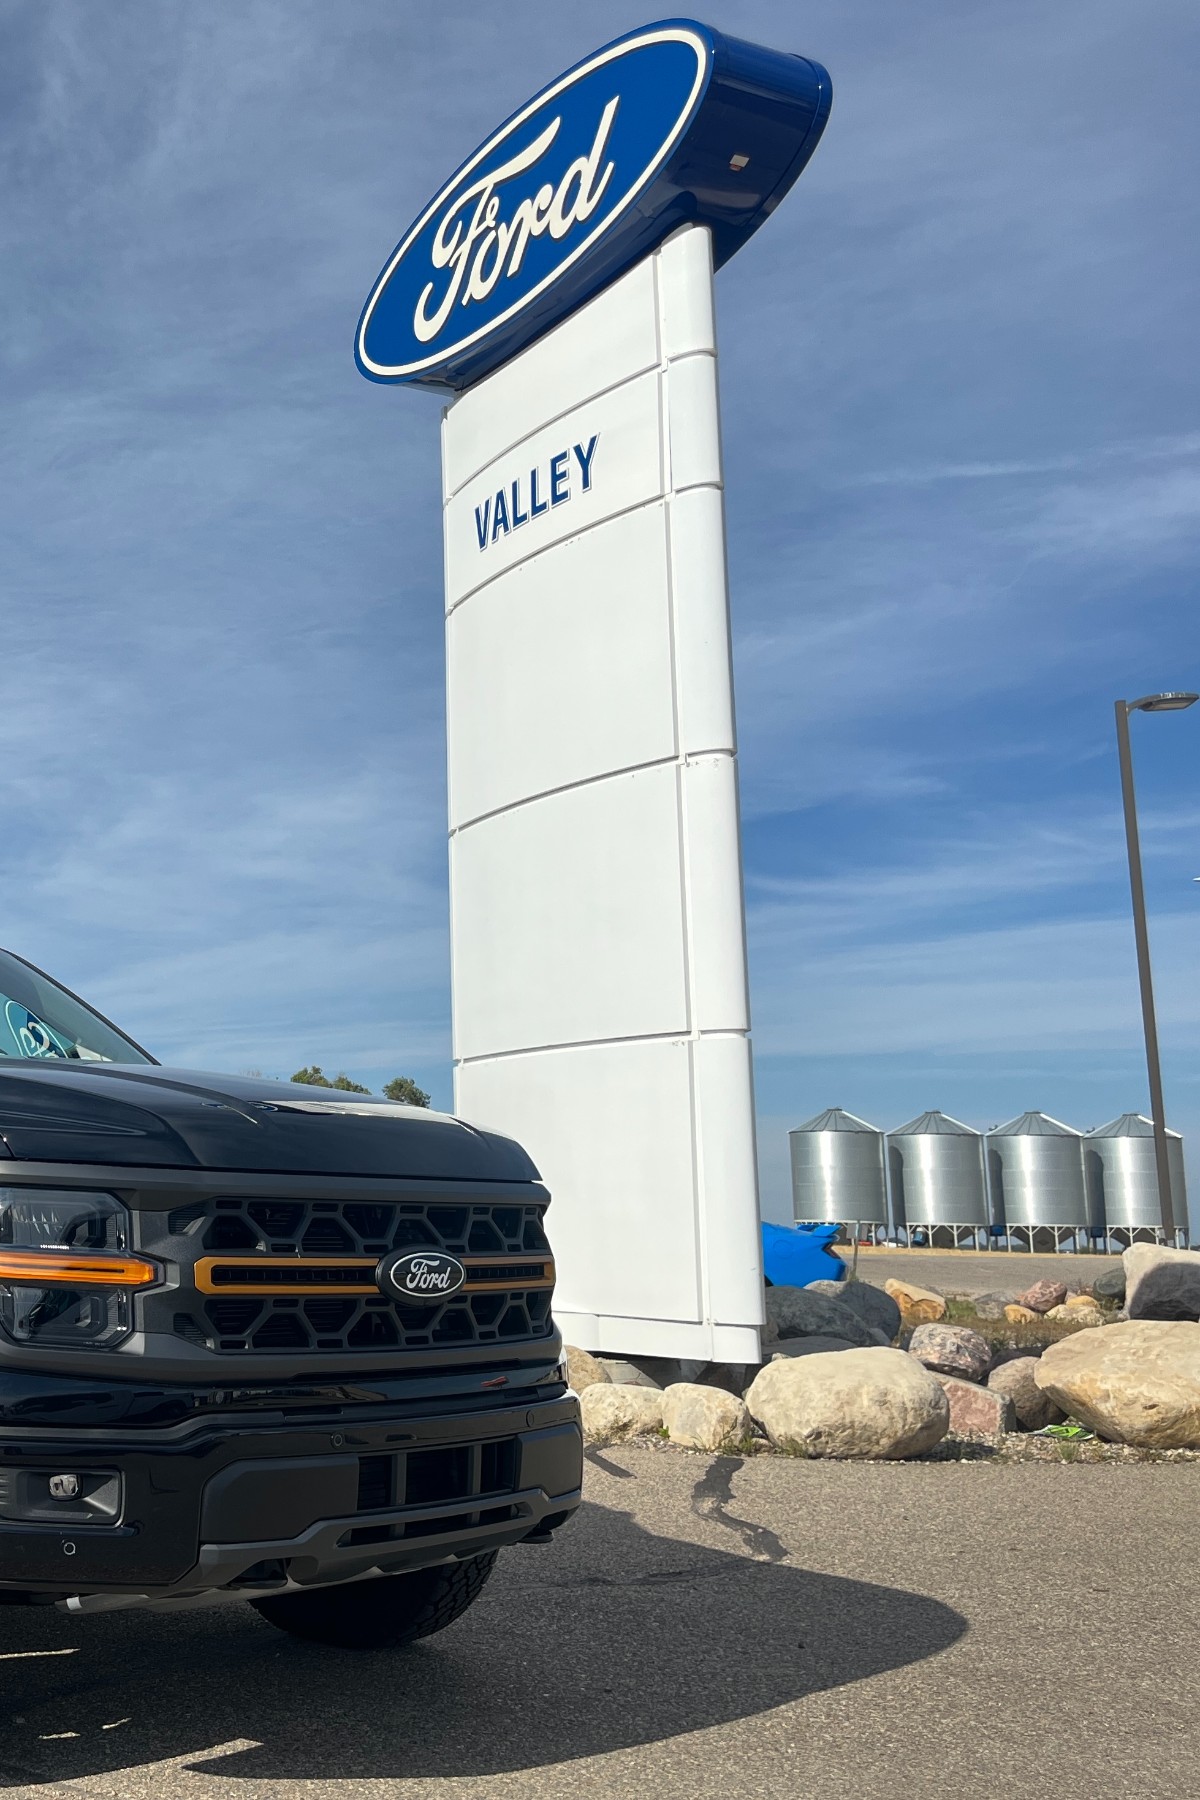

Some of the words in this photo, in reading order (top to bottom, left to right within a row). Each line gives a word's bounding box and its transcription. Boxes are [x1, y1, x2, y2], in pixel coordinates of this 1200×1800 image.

[413, 95, 620, 343] Ford
[474, 433, 600, 552] VALLEY
[406, 1258, 451, 1289] Ford
